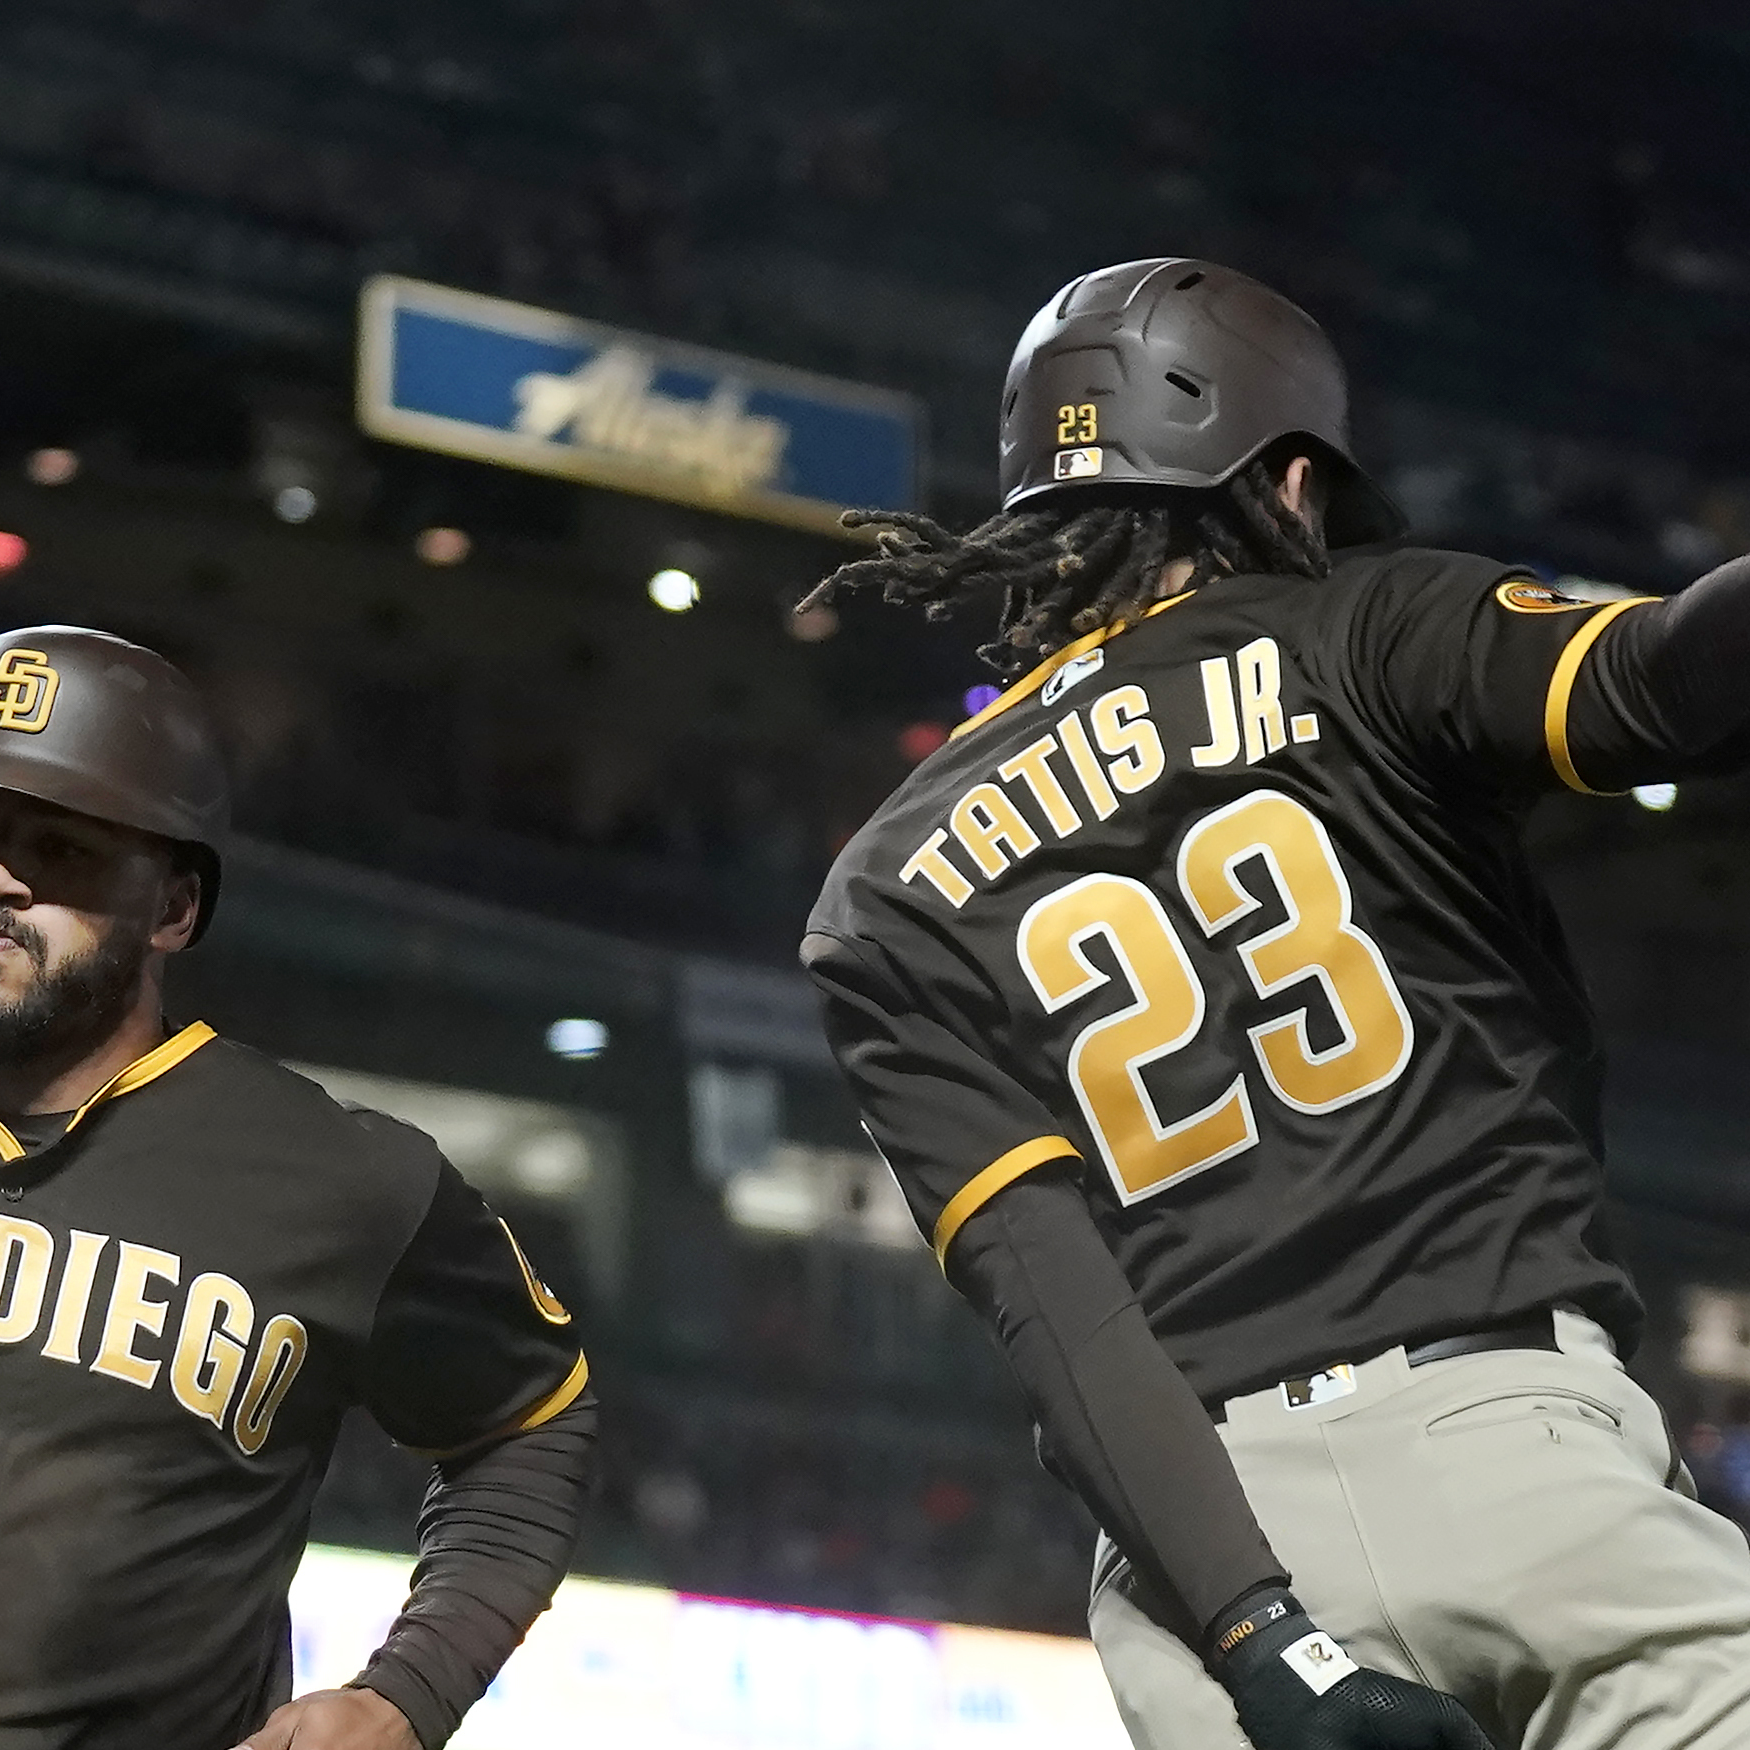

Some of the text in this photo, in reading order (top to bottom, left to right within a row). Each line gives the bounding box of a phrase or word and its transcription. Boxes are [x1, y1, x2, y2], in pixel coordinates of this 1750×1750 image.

[1057, 403, 1098, 444] 23
[899, 637, 1320, 909] TATIS JR.
[1016, 788, 1415, 1208] 23
[1267, 1602, 1286, 1619] 23
